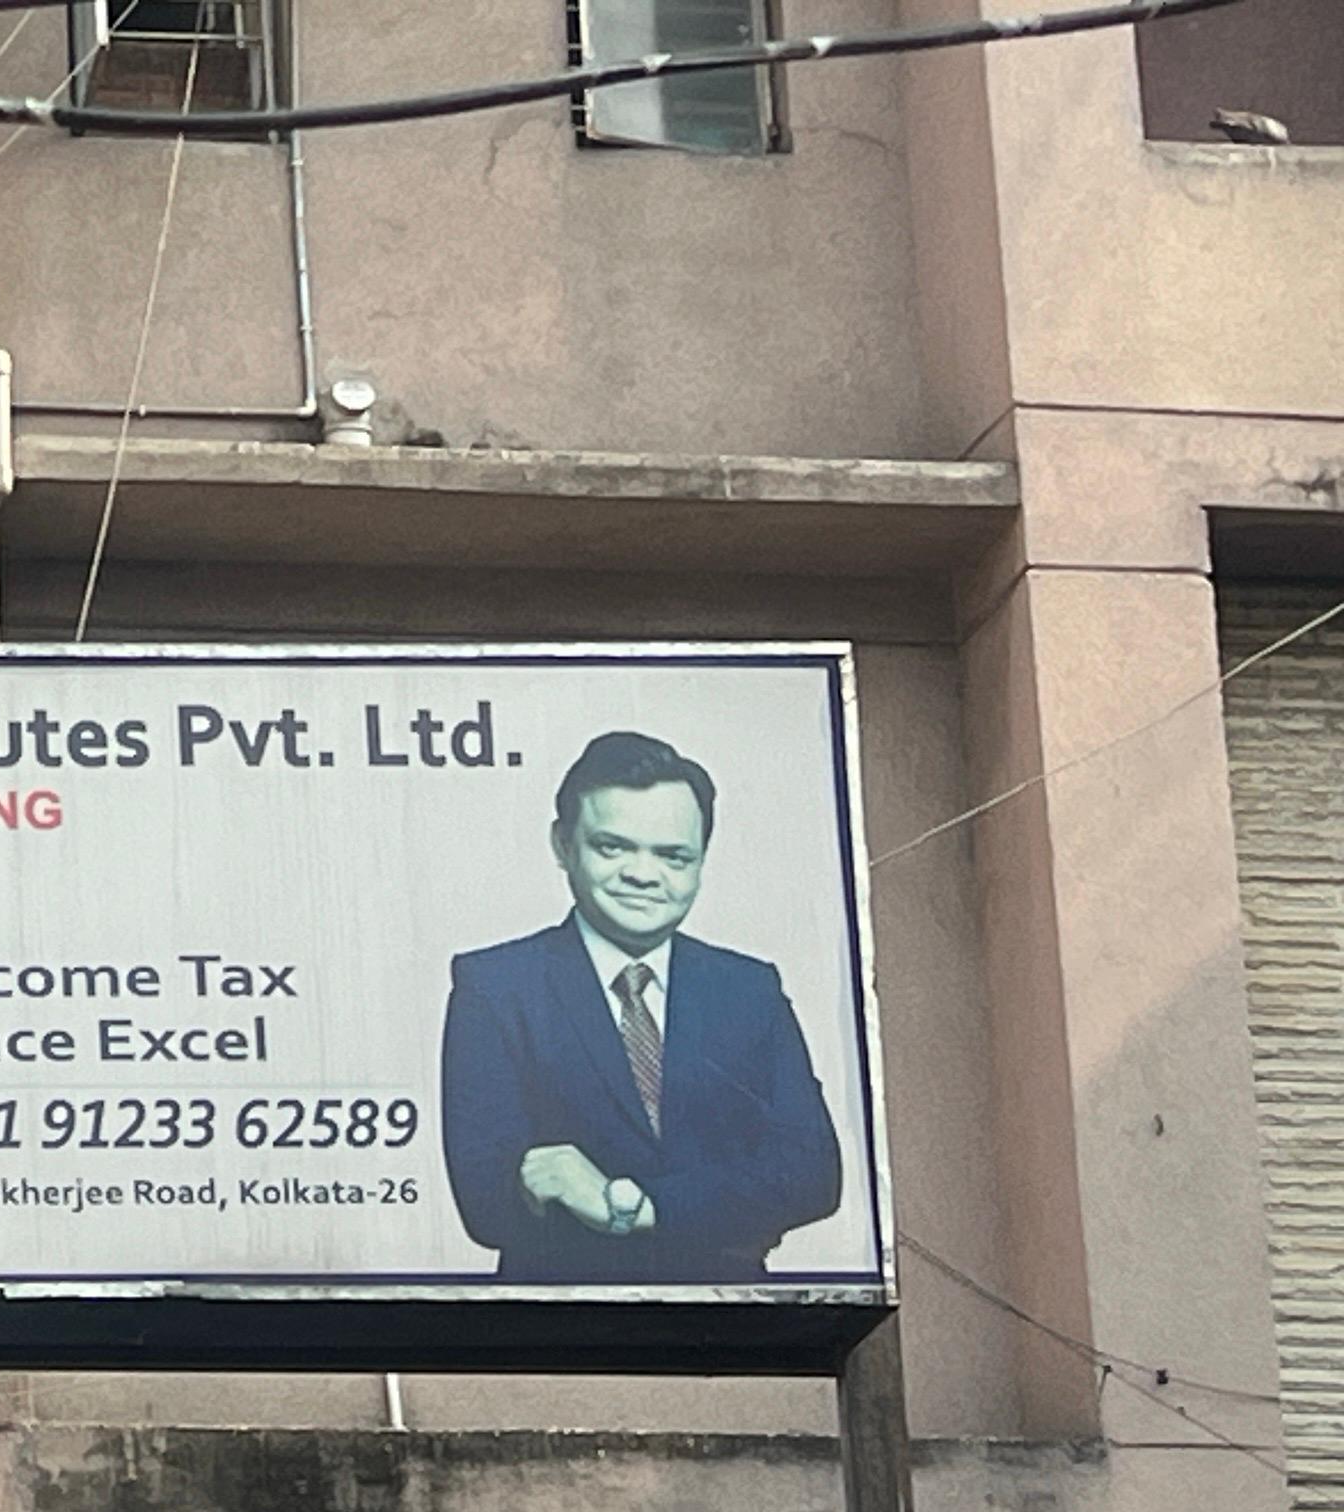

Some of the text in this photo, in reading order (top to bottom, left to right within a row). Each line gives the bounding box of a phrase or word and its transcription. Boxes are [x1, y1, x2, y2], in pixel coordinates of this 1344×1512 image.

[178, 705, 334, 767] Pvt.
[366, 701, 523, 766] Ltd.
[179, 955, 298, 998] Tax
[98, 1016, 267, 1062] Excel
[40, 1100, 216, 1149] 91233
[234, 1100, 419, 1149] 62589
[134, 1178, 227, 1212] Road,
[239, 1178, 419, 1207] Kolkata-26
